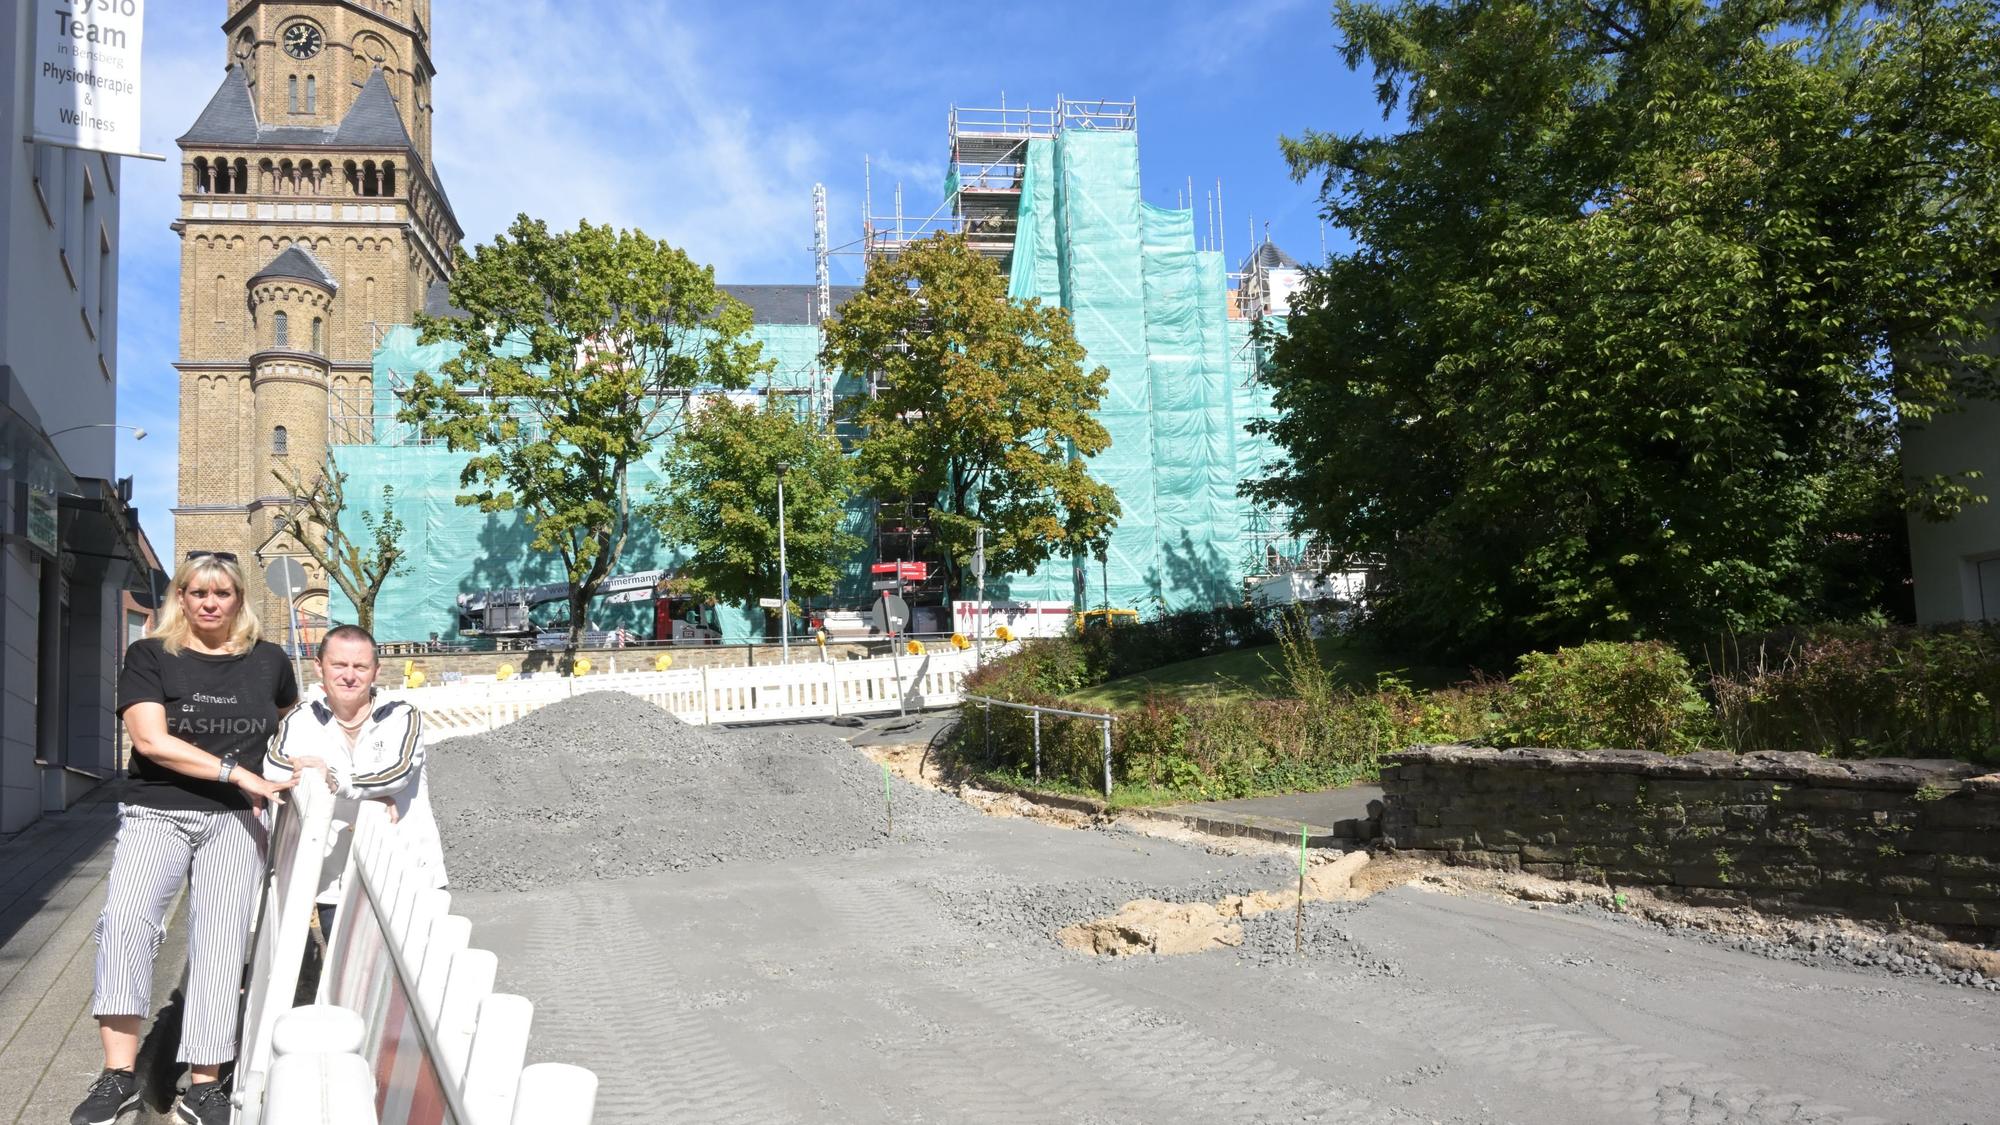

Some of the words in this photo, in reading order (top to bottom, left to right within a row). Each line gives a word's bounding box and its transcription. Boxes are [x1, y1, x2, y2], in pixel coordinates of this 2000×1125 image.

[64, 0, 136, 16] ysio
[55, 9, 126, 49] Team
[57, 42, 68, 55] in
[72, 45, 124, 69] Bensberg
[43, 62, 134, 95] Physiotherapie
[84, 92, 93, 105] &
[59, 107, 116, 132] Wellness
[167, 717, 267, 734] FASHION
